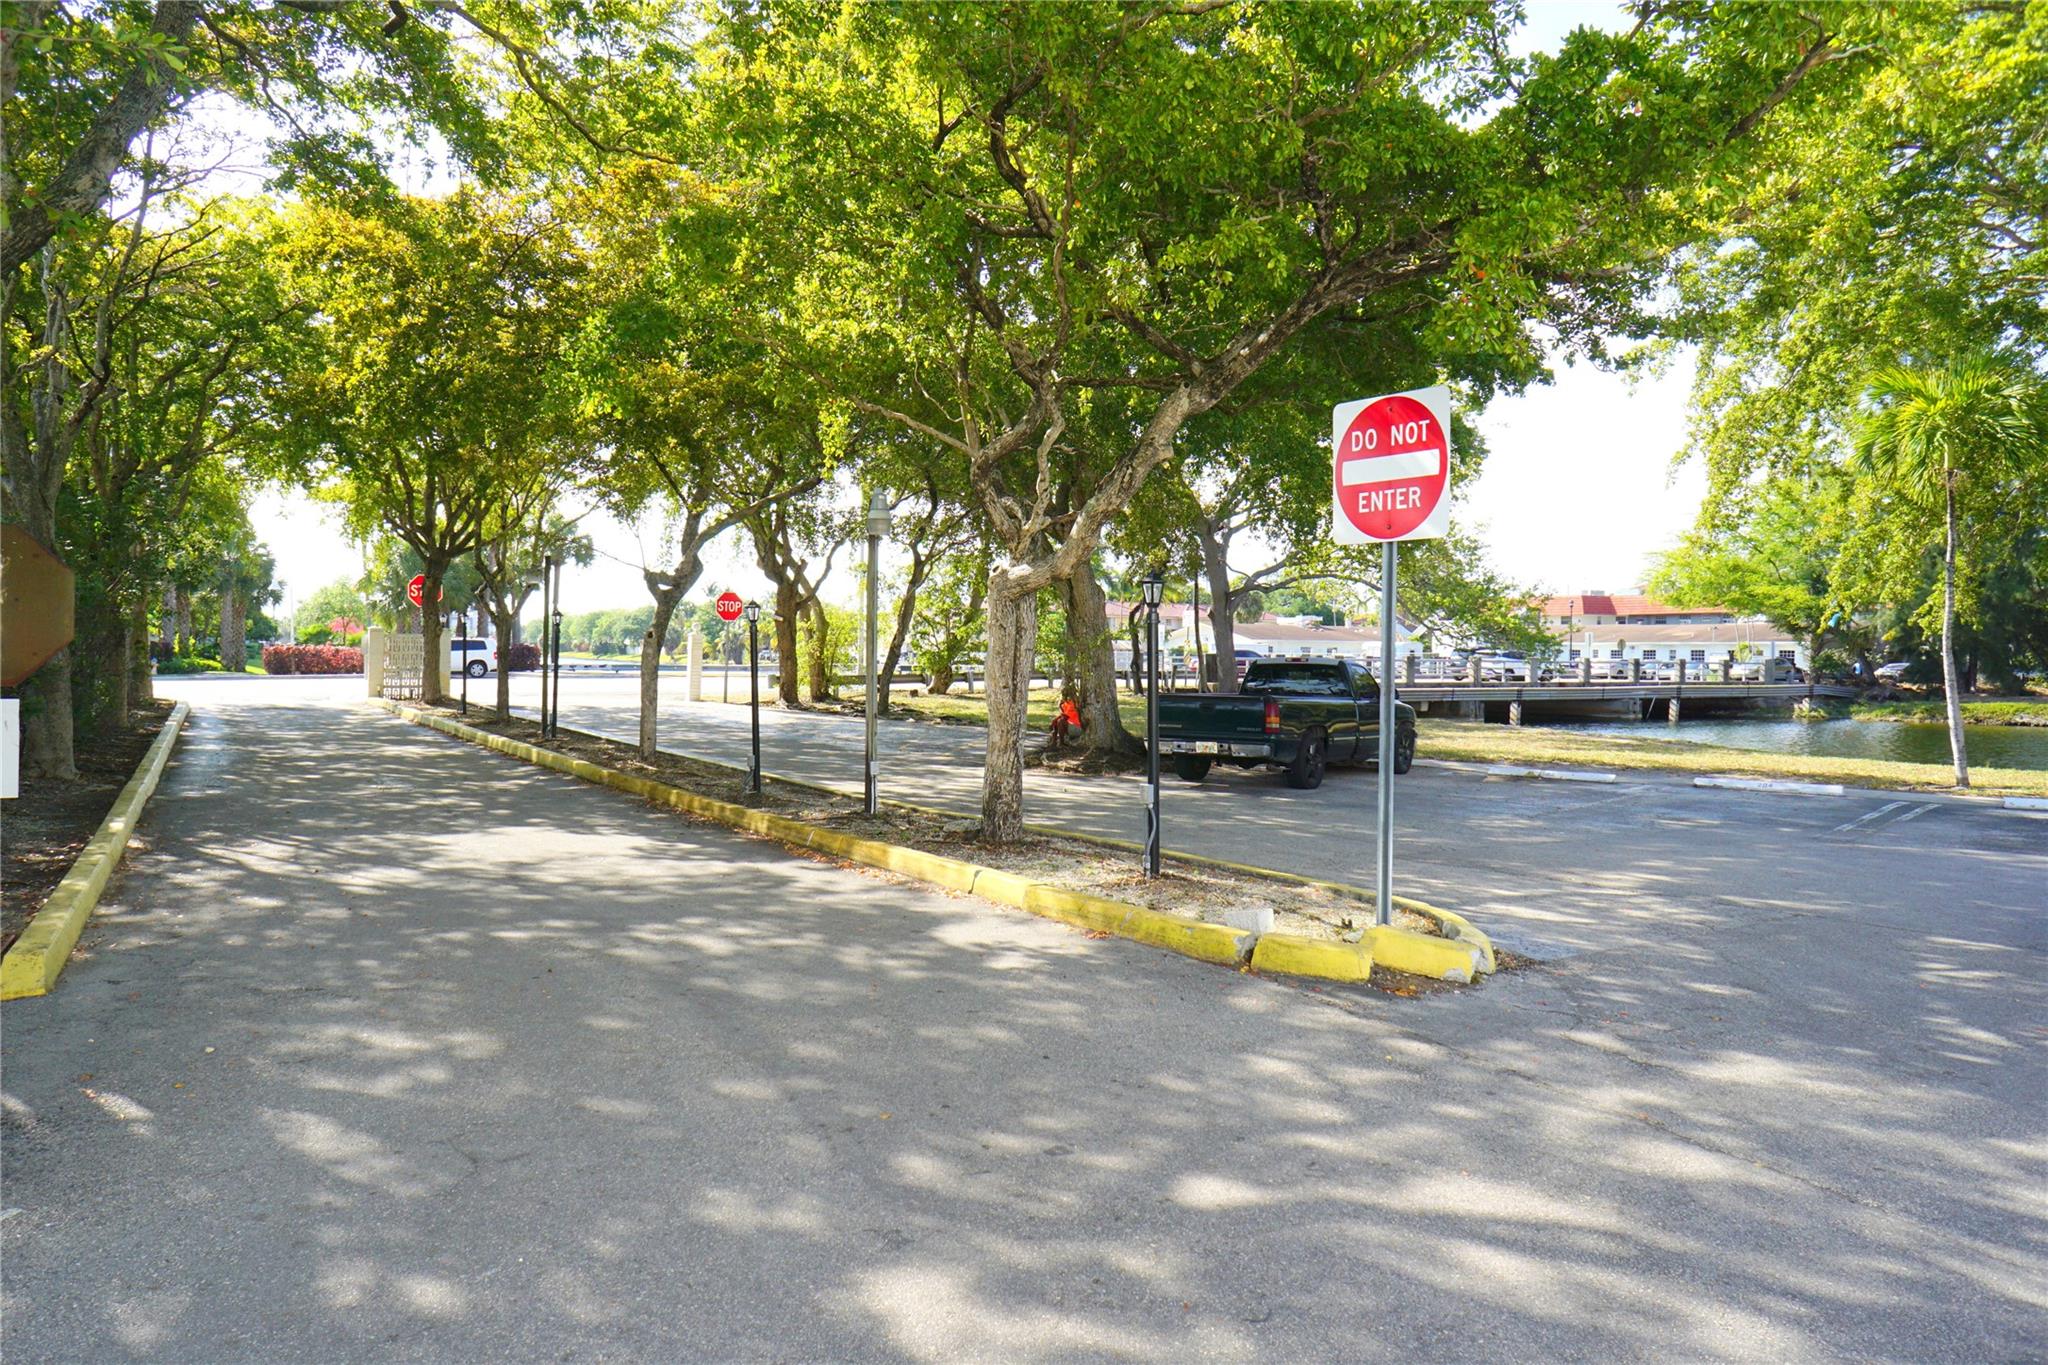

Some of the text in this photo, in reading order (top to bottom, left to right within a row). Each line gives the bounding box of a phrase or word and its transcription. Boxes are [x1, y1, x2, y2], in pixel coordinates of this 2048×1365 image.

[1351, 419, 1430, 452] DO NOT
[1358, 486, 1421, 513] ENTER
[718, 600, 742, 612] STOP
